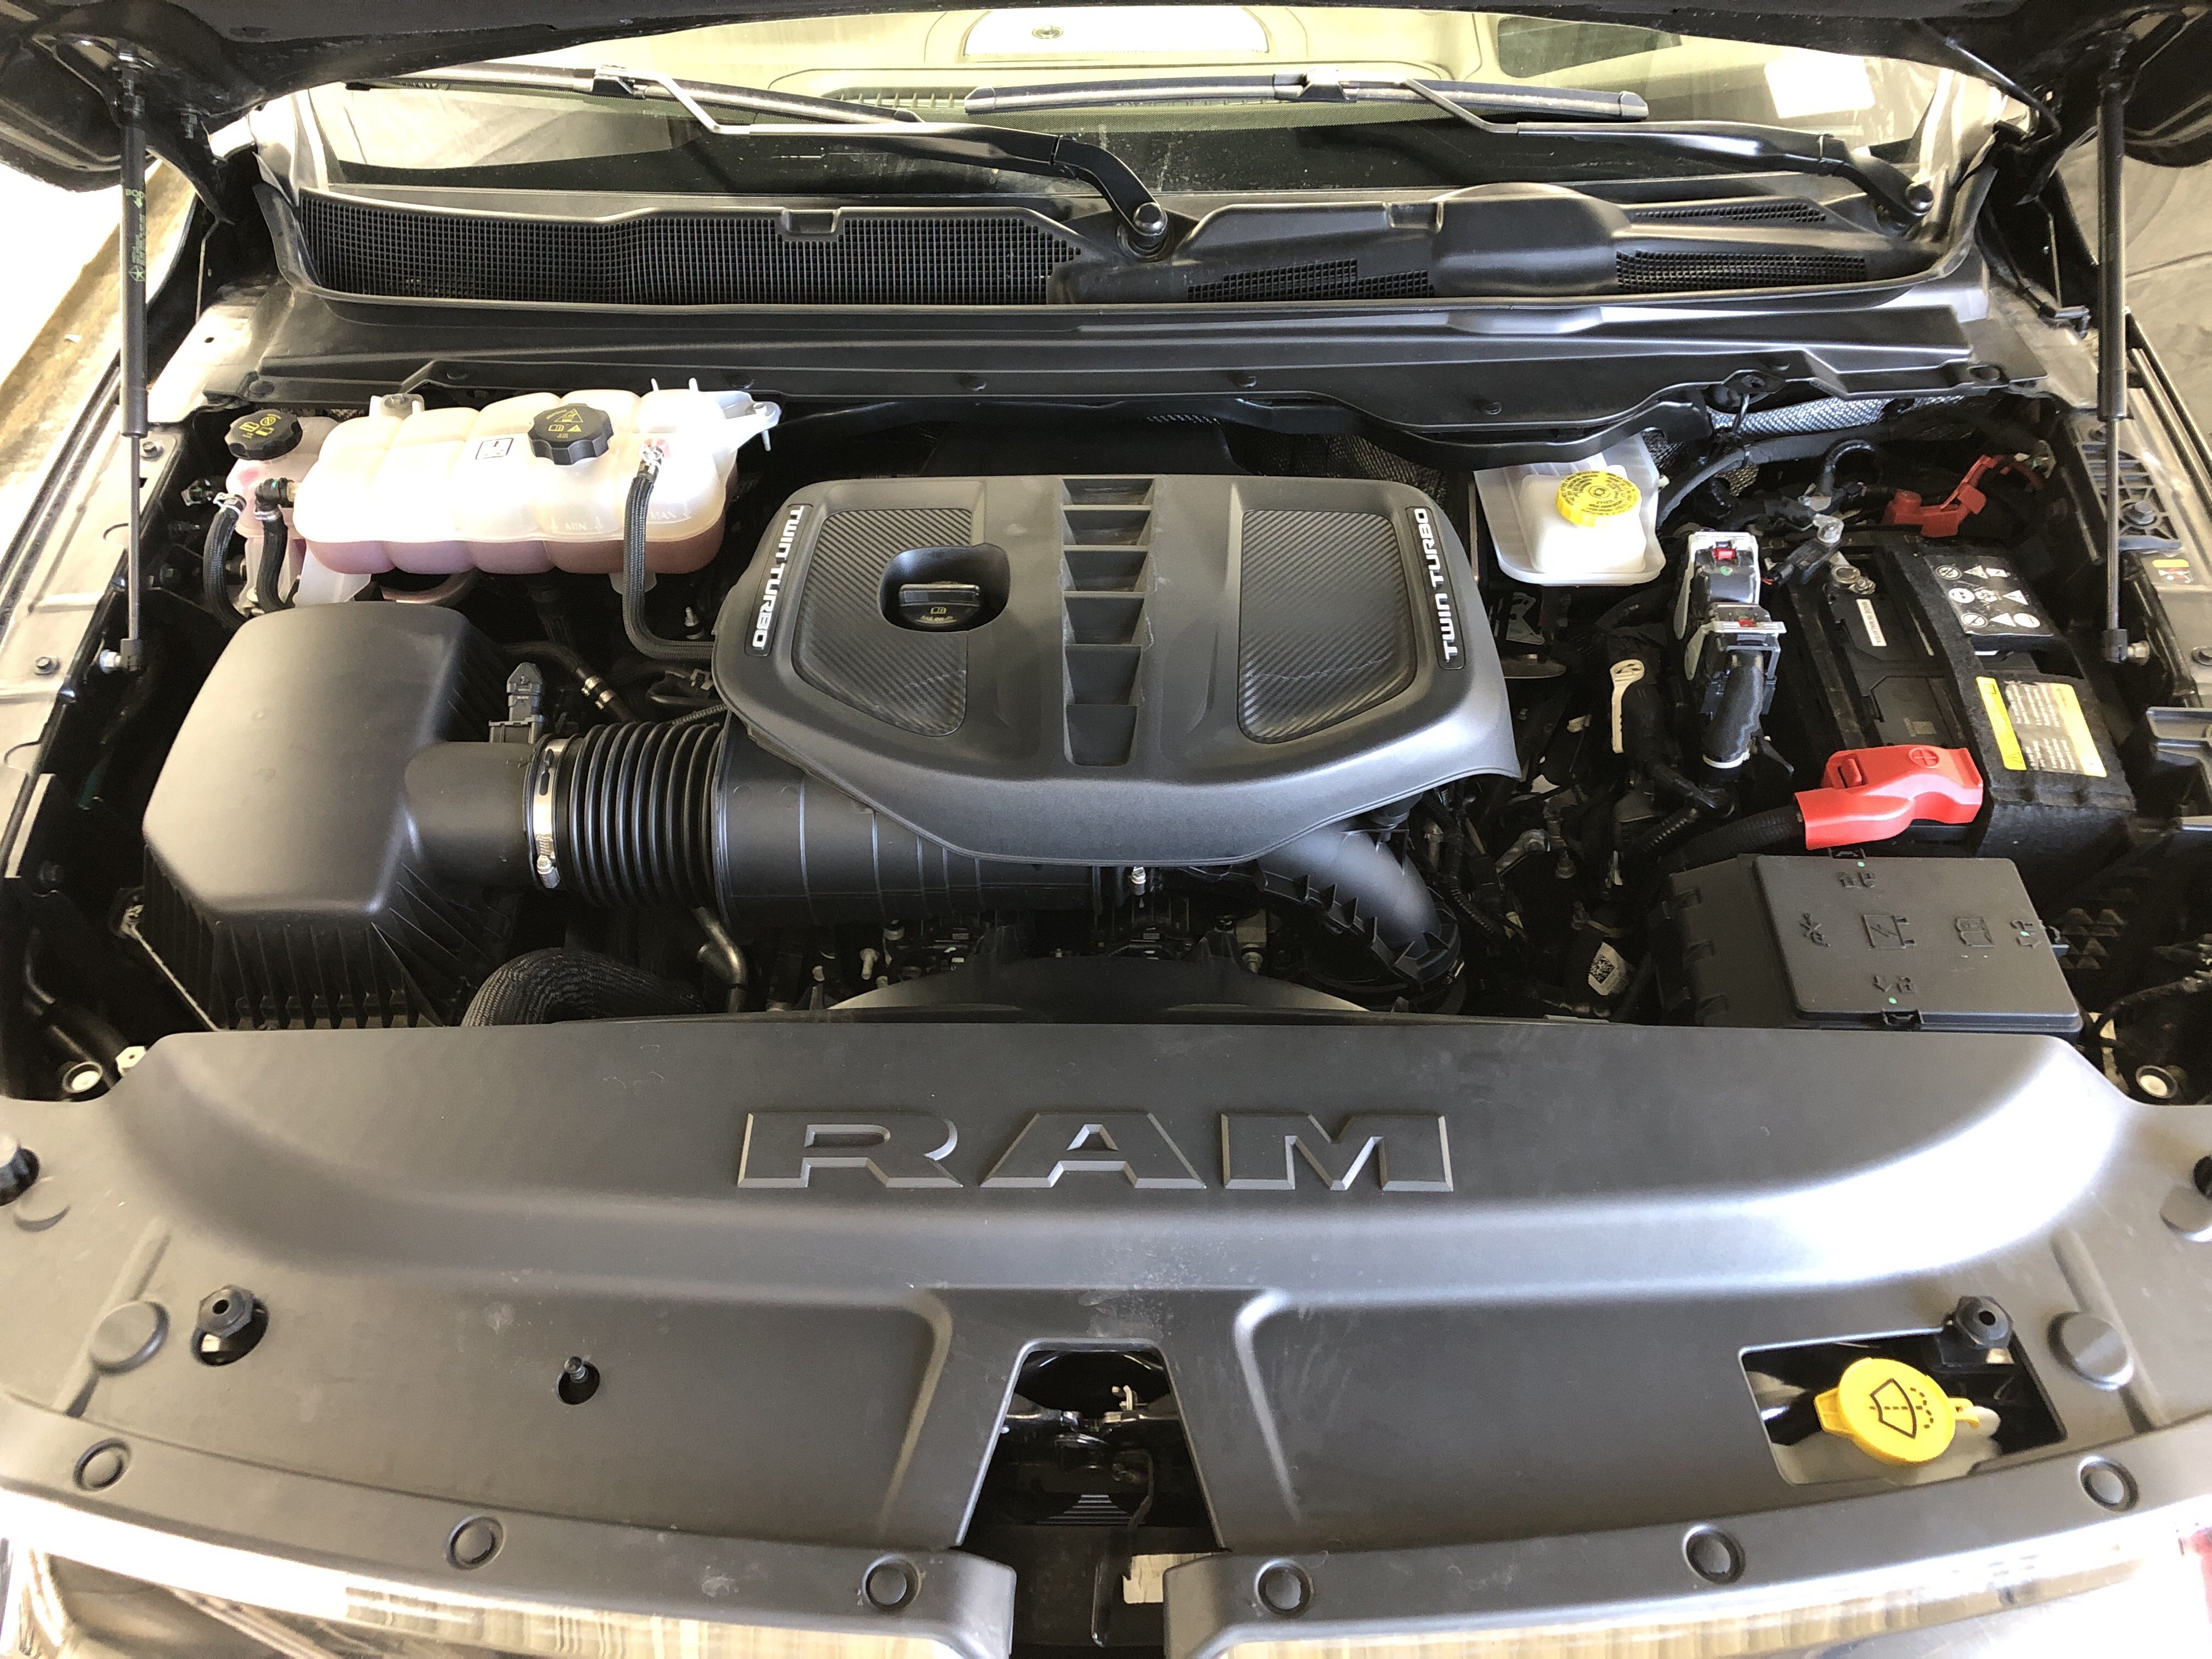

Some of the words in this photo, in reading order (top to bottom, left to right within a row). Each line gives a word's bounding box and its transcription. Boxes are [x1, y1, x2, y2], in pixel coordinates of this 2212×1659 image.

[125, 188, 145, 199] BOD
[565, 522, 587, 531] MIN
[650, 511, 676, 520] MAX
[776, 505, 804, 561] TWIN
[1414, 508, 1444, 588] TURBO
[752, 563, 785, 648] TURBO
[1435, 593, 1458, 661] TWIN
[737, 1111, 1455, 1192] RAM
